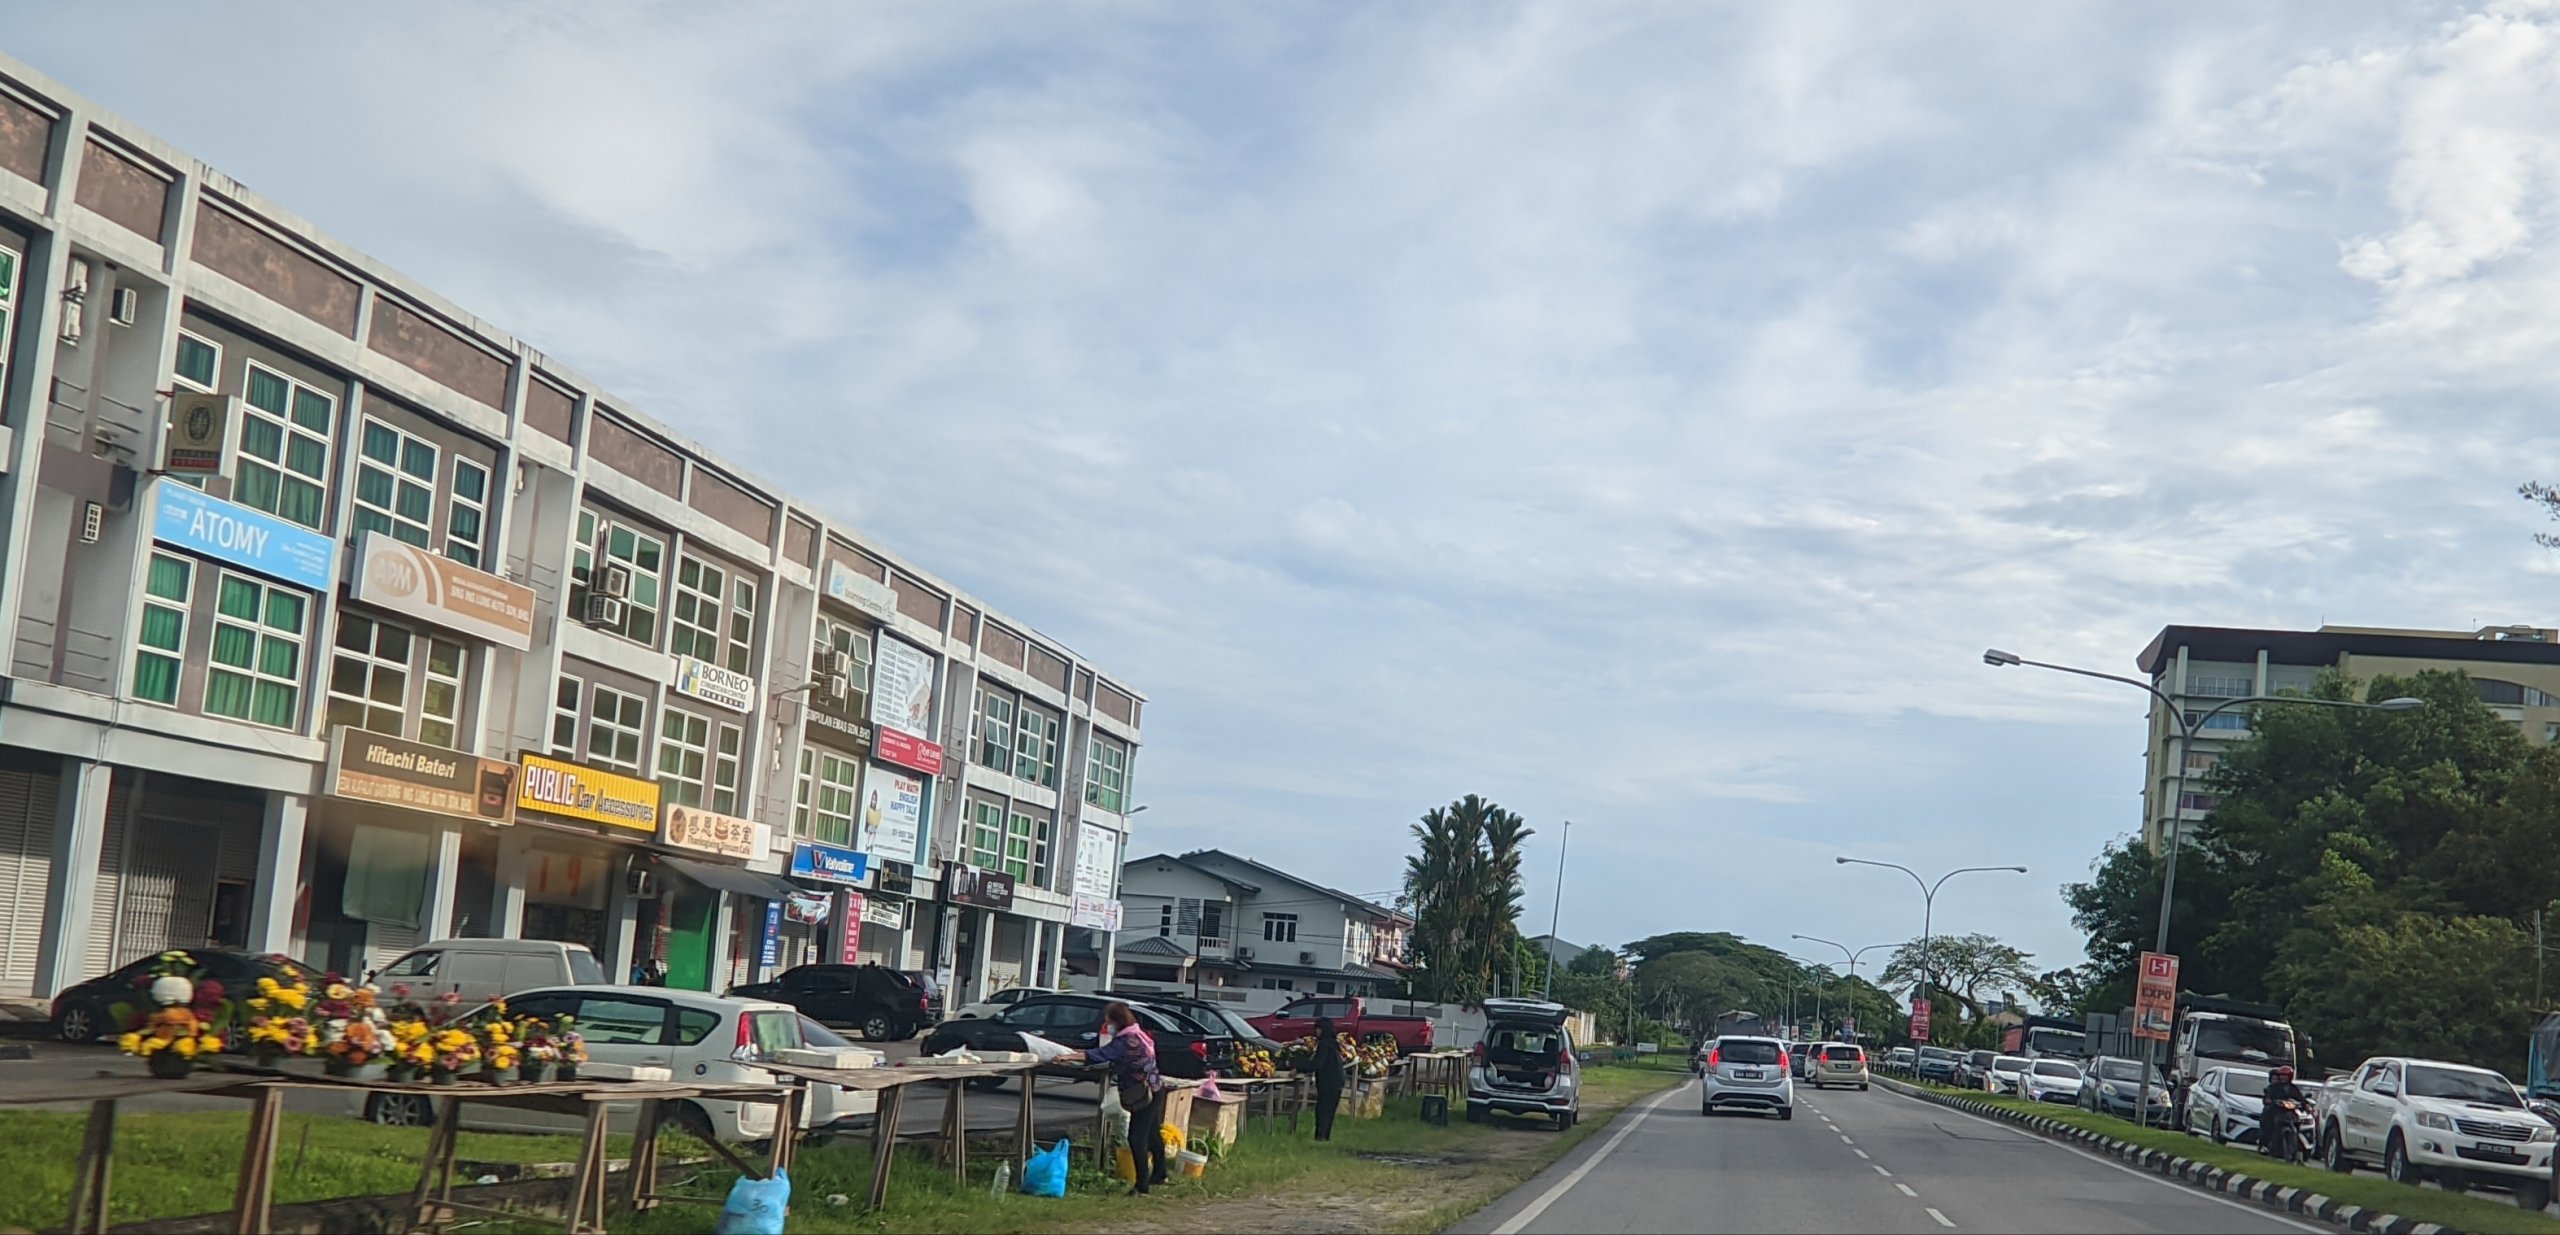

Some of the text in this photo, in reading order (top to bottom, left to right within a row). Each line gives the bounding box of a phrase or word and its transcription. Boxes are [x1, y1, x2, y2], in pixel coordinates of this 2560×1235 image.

[189, 506, 269, 559] ATOMY
[701, 664, 749, 692] BORNEO
[365, 743, 457, 779] Hitachi Bateri
[523, 764, 654, 823] PUBLIC Car Accessories
[825, 856, 855, 874] Valvoline
[2142, 987, 2172, 1000] EXPO
